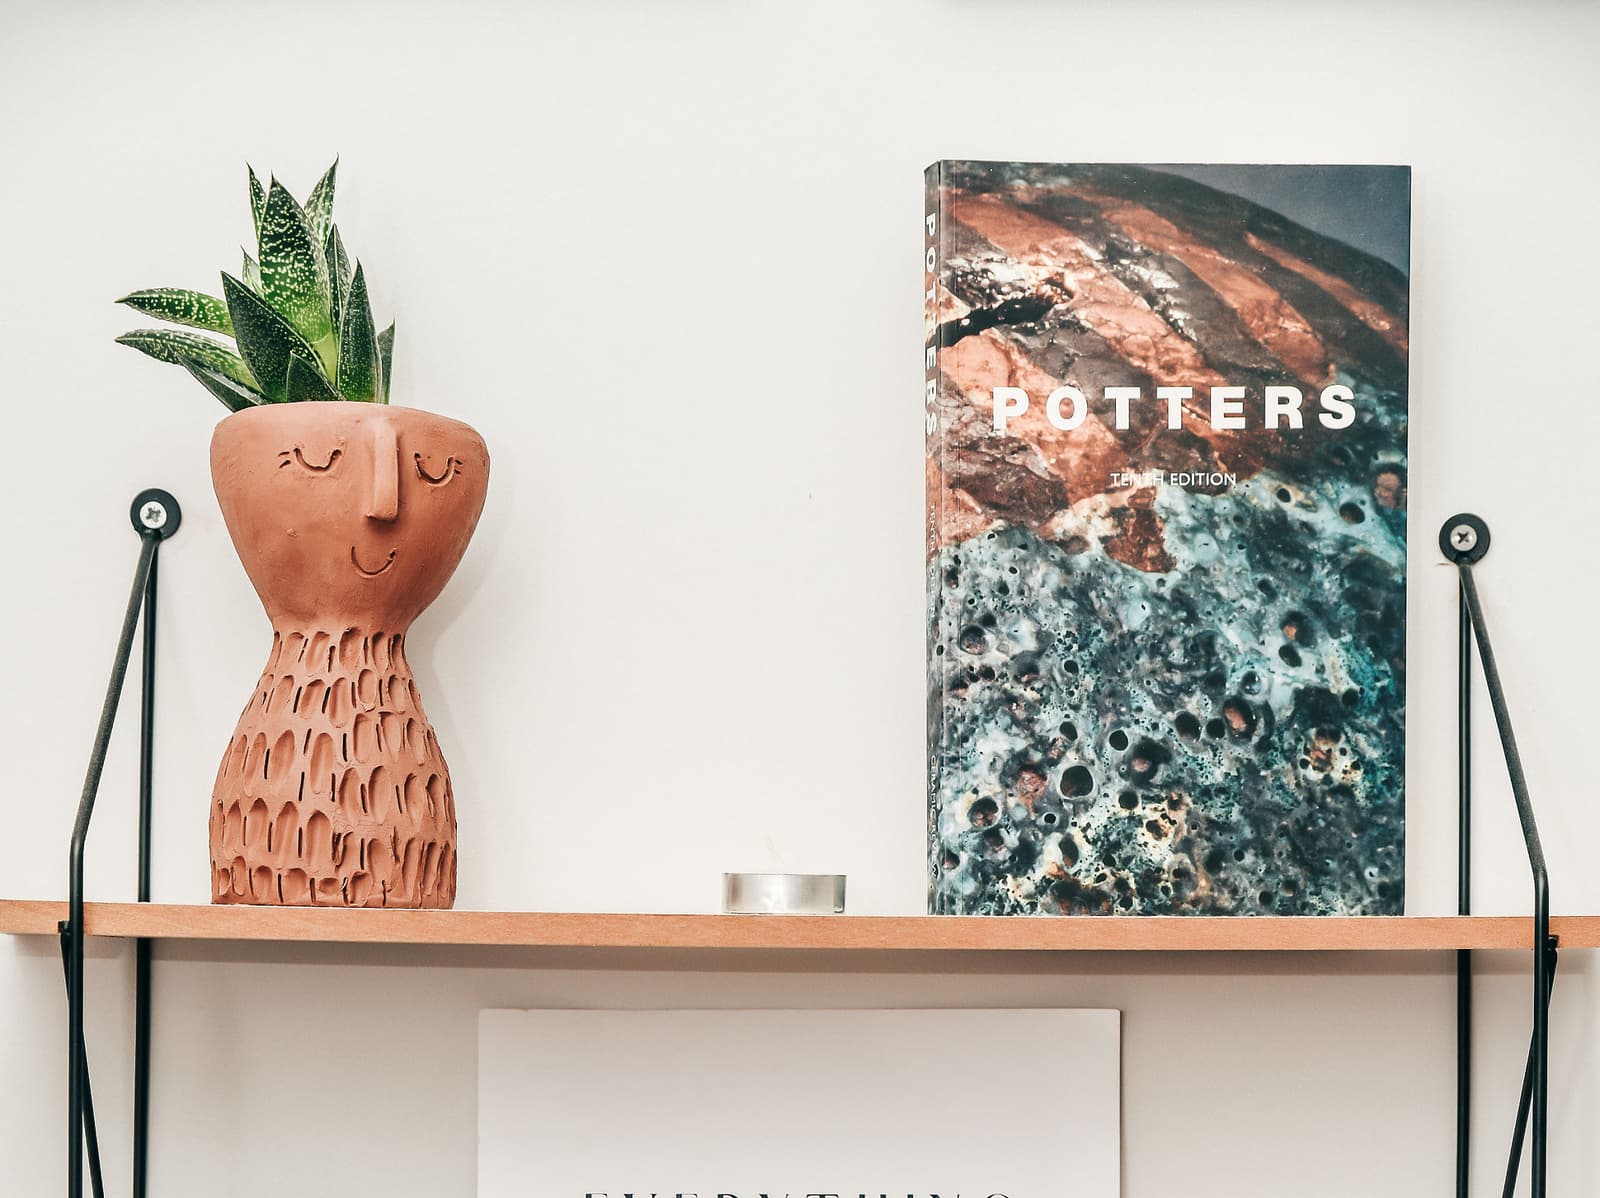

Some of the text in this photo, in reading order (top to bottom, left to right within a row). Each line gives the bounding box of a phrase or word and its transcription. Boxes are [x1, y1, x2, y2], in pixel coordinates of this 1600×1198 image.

[926, 212, 937, 436] POTTERS
[992, 384, 1357, 430] POTTERS
[1110, 472, 1237, 487] TENTH EDITION
[929, 754, 937, 818] CERAMIC
